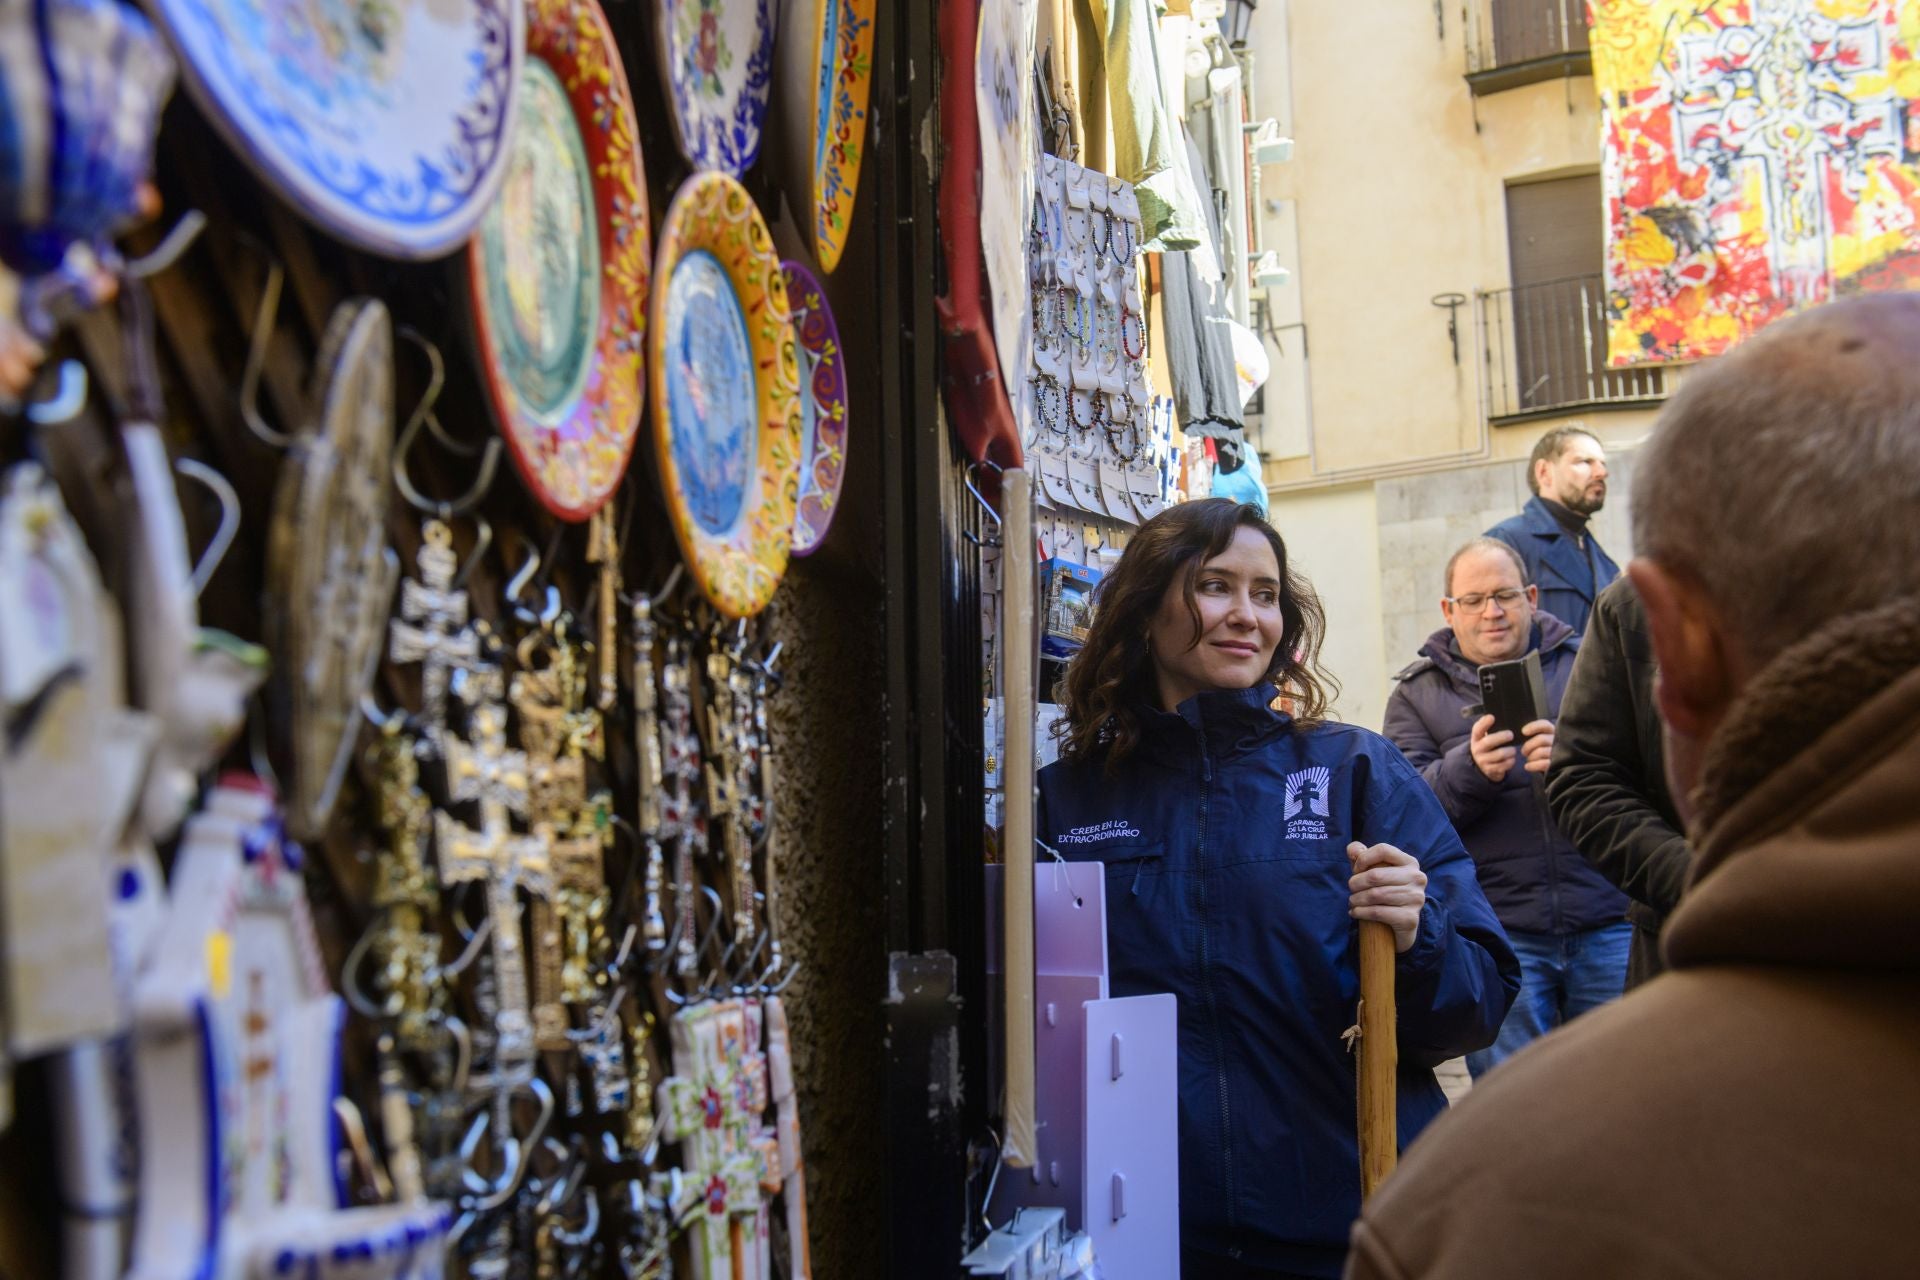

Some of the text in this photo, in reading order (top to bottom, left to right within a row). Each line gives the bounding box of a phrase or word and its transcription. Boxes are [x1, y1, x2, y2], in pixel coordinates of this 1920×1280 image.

[1071, 820, 1128, 835] CREER EN LO
[1058, 829, 1140, 844] EXTRAORDINARIO
